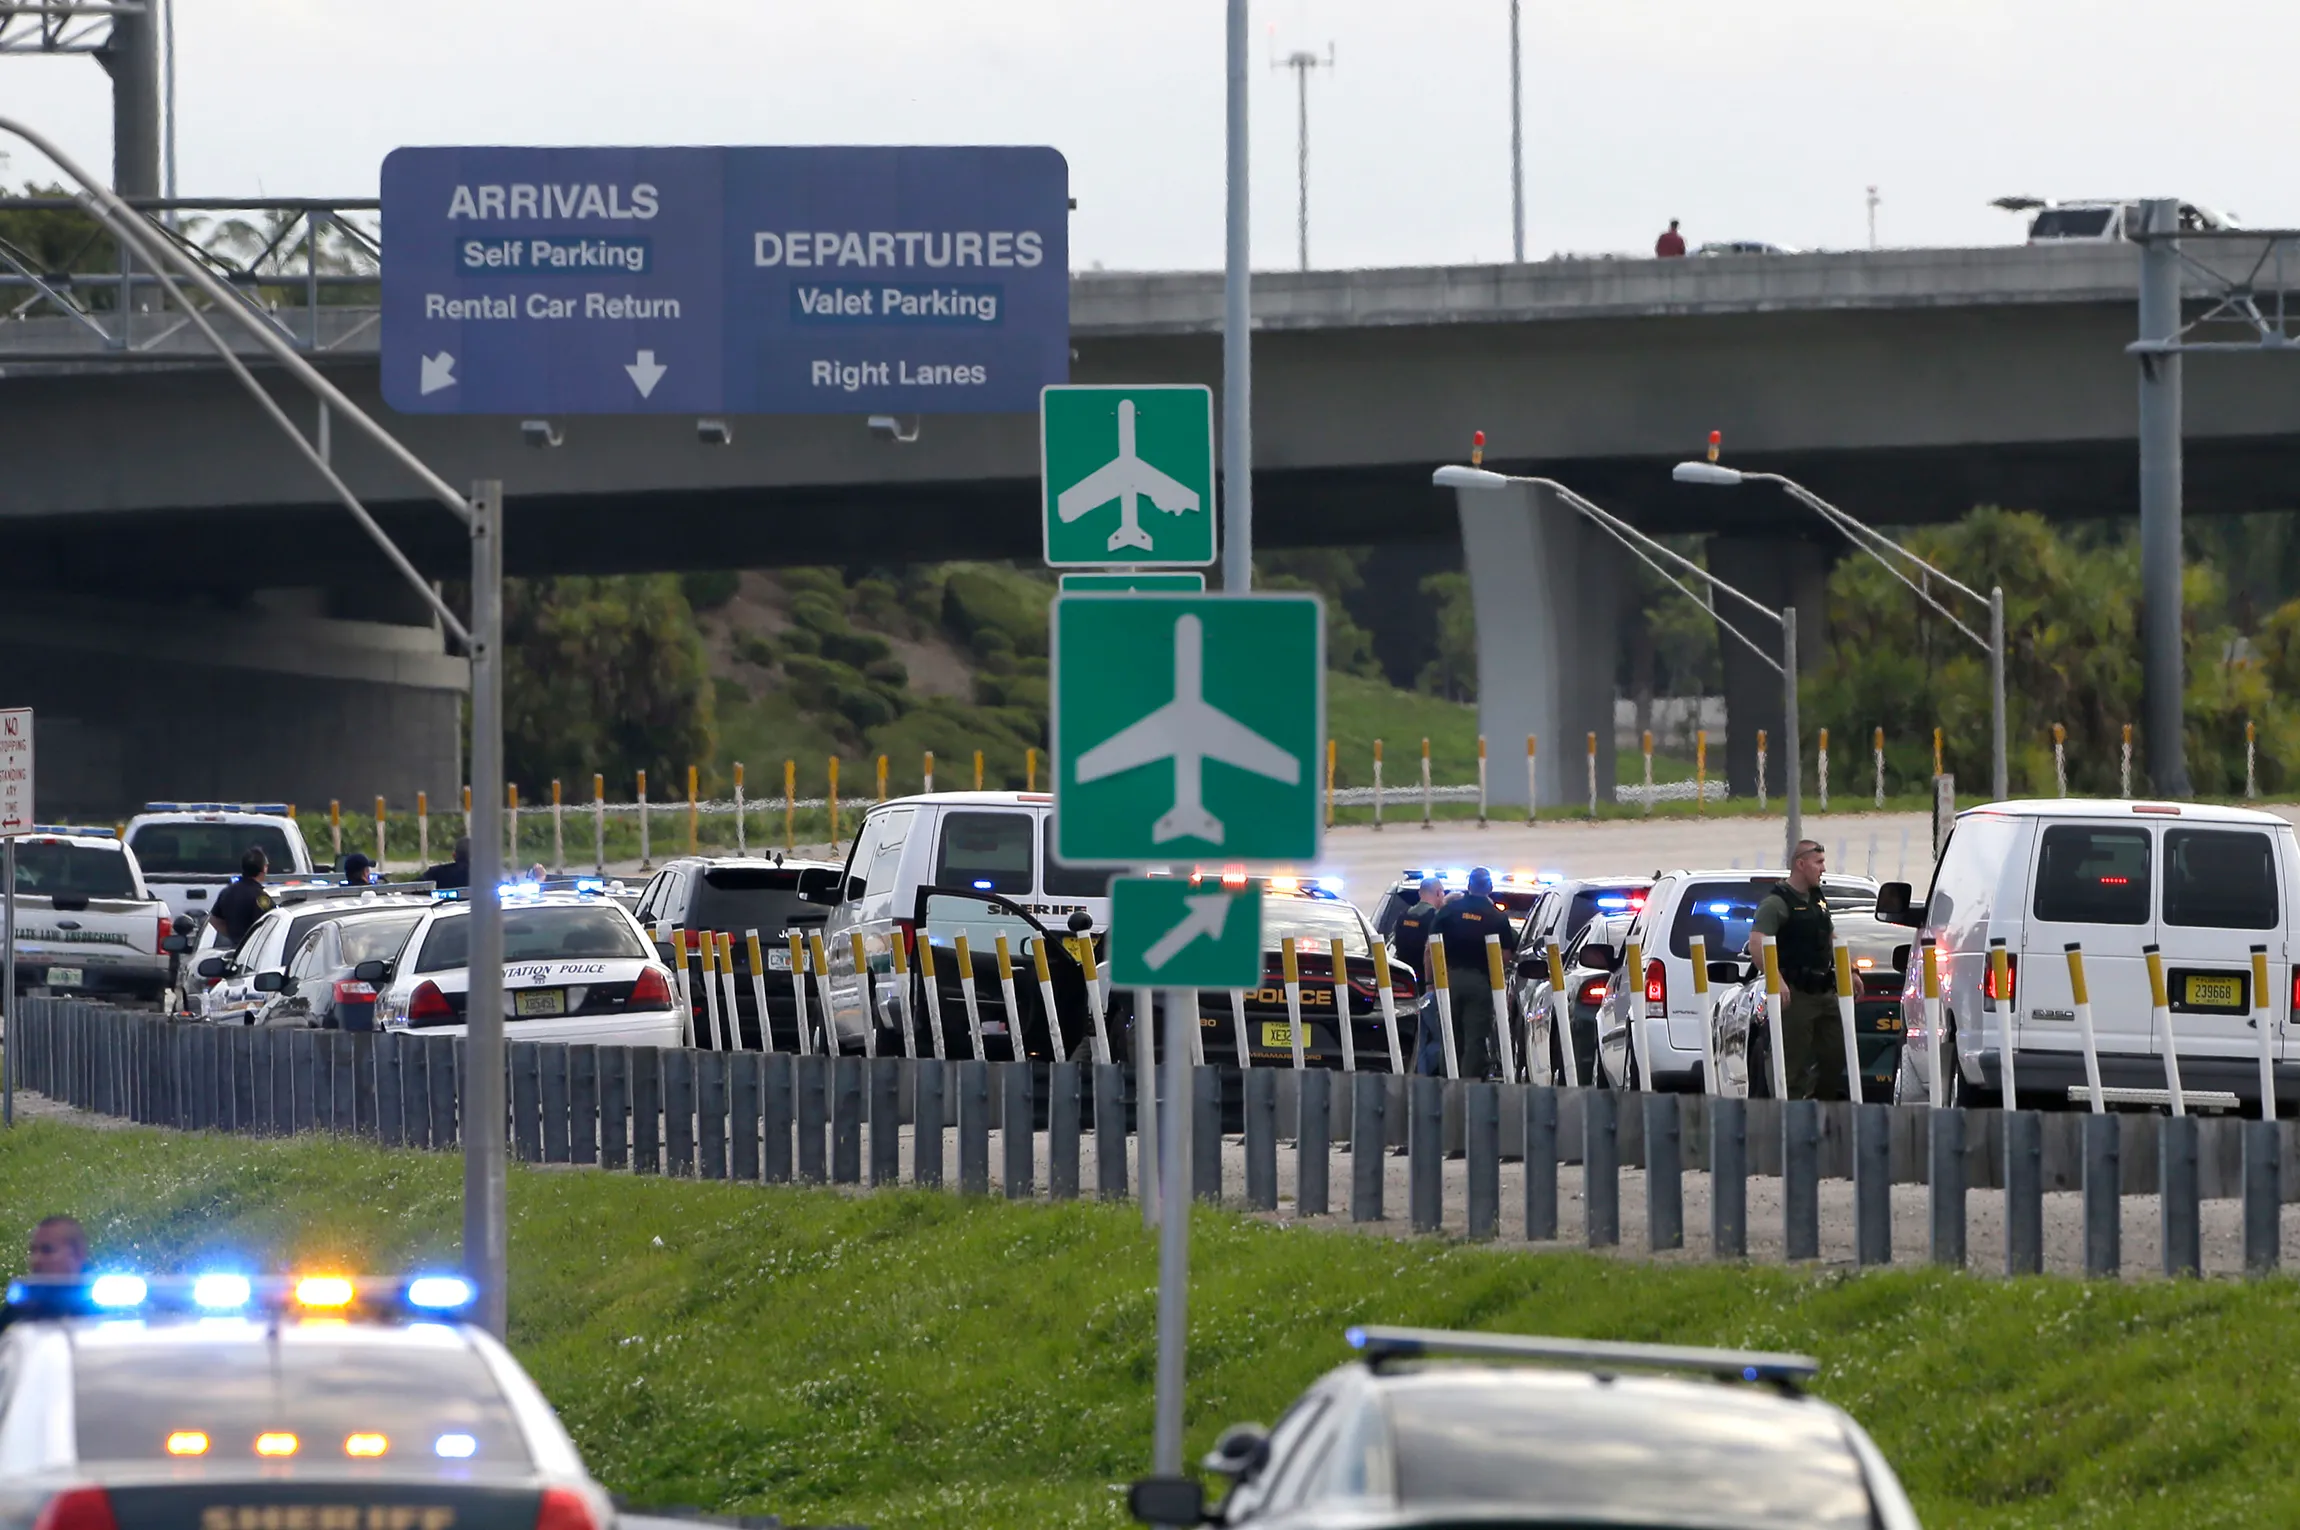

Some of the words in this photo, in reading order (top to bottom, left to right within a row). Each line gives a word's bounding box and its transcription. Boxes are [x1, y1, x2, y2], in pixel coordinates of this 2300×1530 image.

[447, 184, 659, 219] ARRIVALS
[464, 241, 522, 267] Self
[531, 240, 645, 271] Parking
[754, 232, 1043, 267] DEPARTURES
[425, 294, 517, 319] Rental
[526, 294, 577, 319] Car
[585, 293, 681, 319] Return
[798, 288, 873, 315] Valet
[883, 288, 997, 321] Parking
[811, 360, 890, 391] Right
[898, 360, 987, 385] Lanes
[4, 717, 19, 736] NO
[559, 963, 607, 975] POLICE
[1243, 988, 1332, 1005] POLCE
[2195, 984, 2231, 999] 239668
[203, 1503, 456, 1530] SHERIFF
